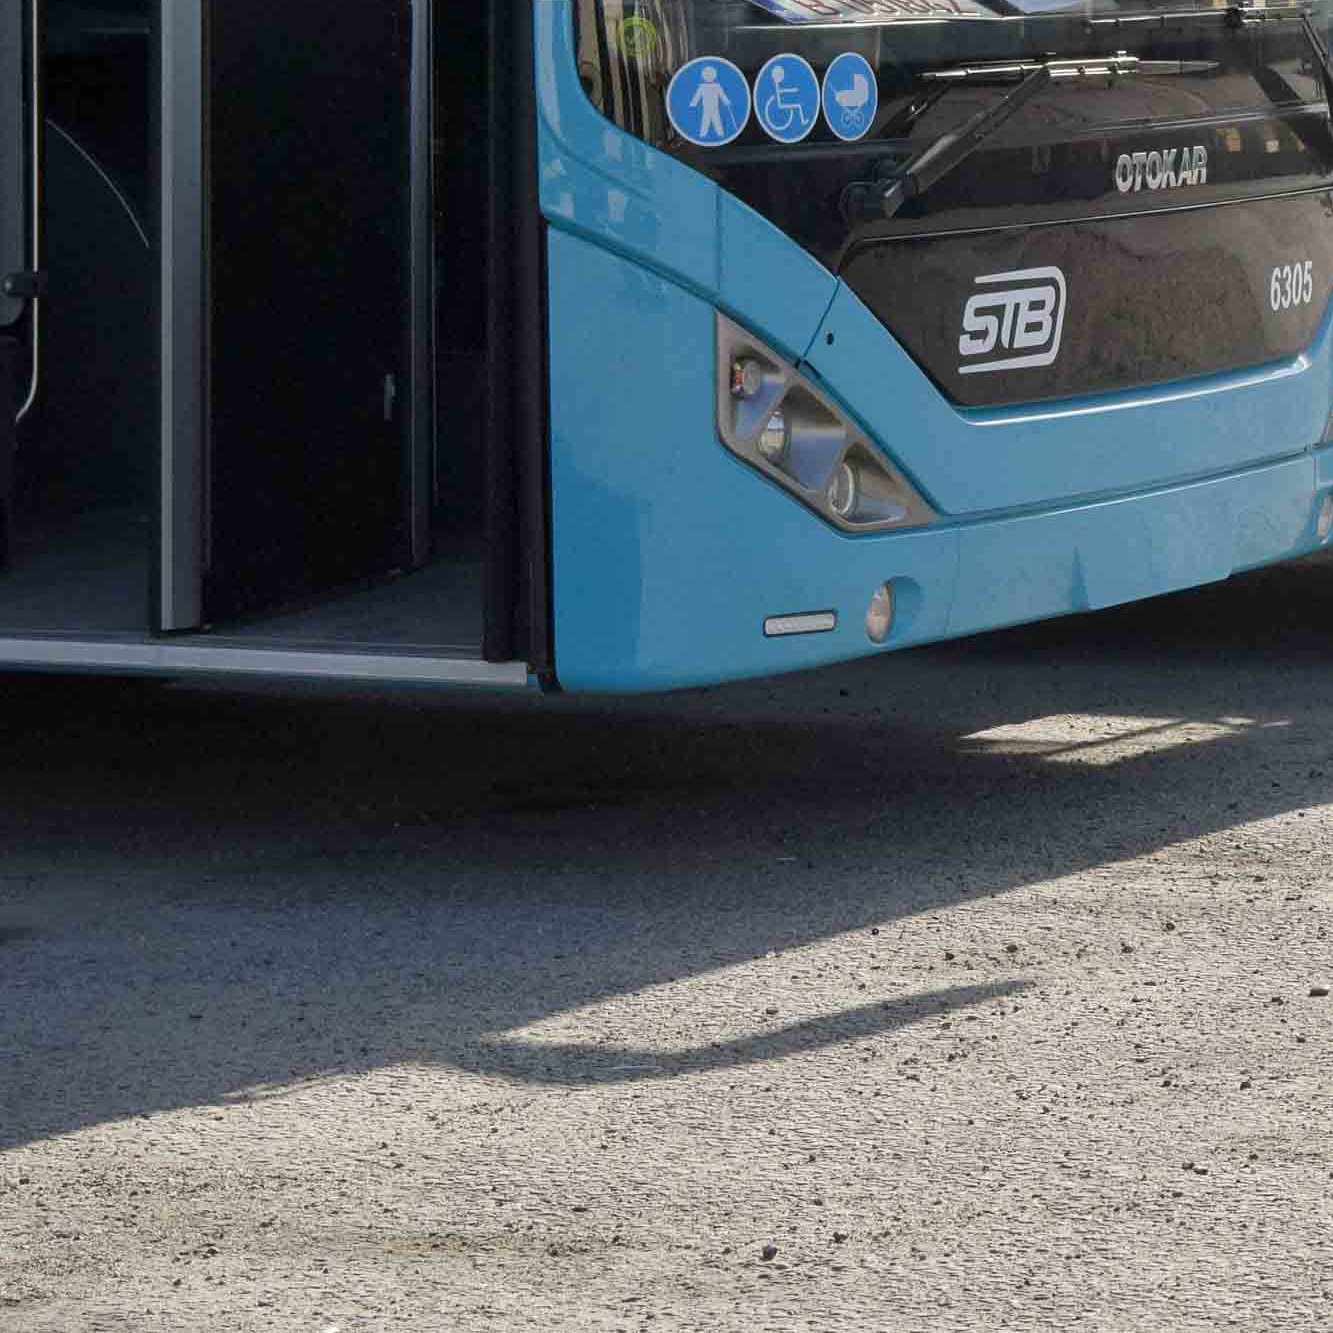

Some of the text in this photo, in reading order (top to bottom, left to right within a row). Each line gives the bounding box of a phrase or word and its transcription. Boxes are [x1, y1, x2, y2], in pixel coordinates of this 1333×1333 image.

[1115, 145, 1209, 193] OTOKAR
[1270, 261, 1313, 311] 6305
[958, 284, 1057, 357] STB
